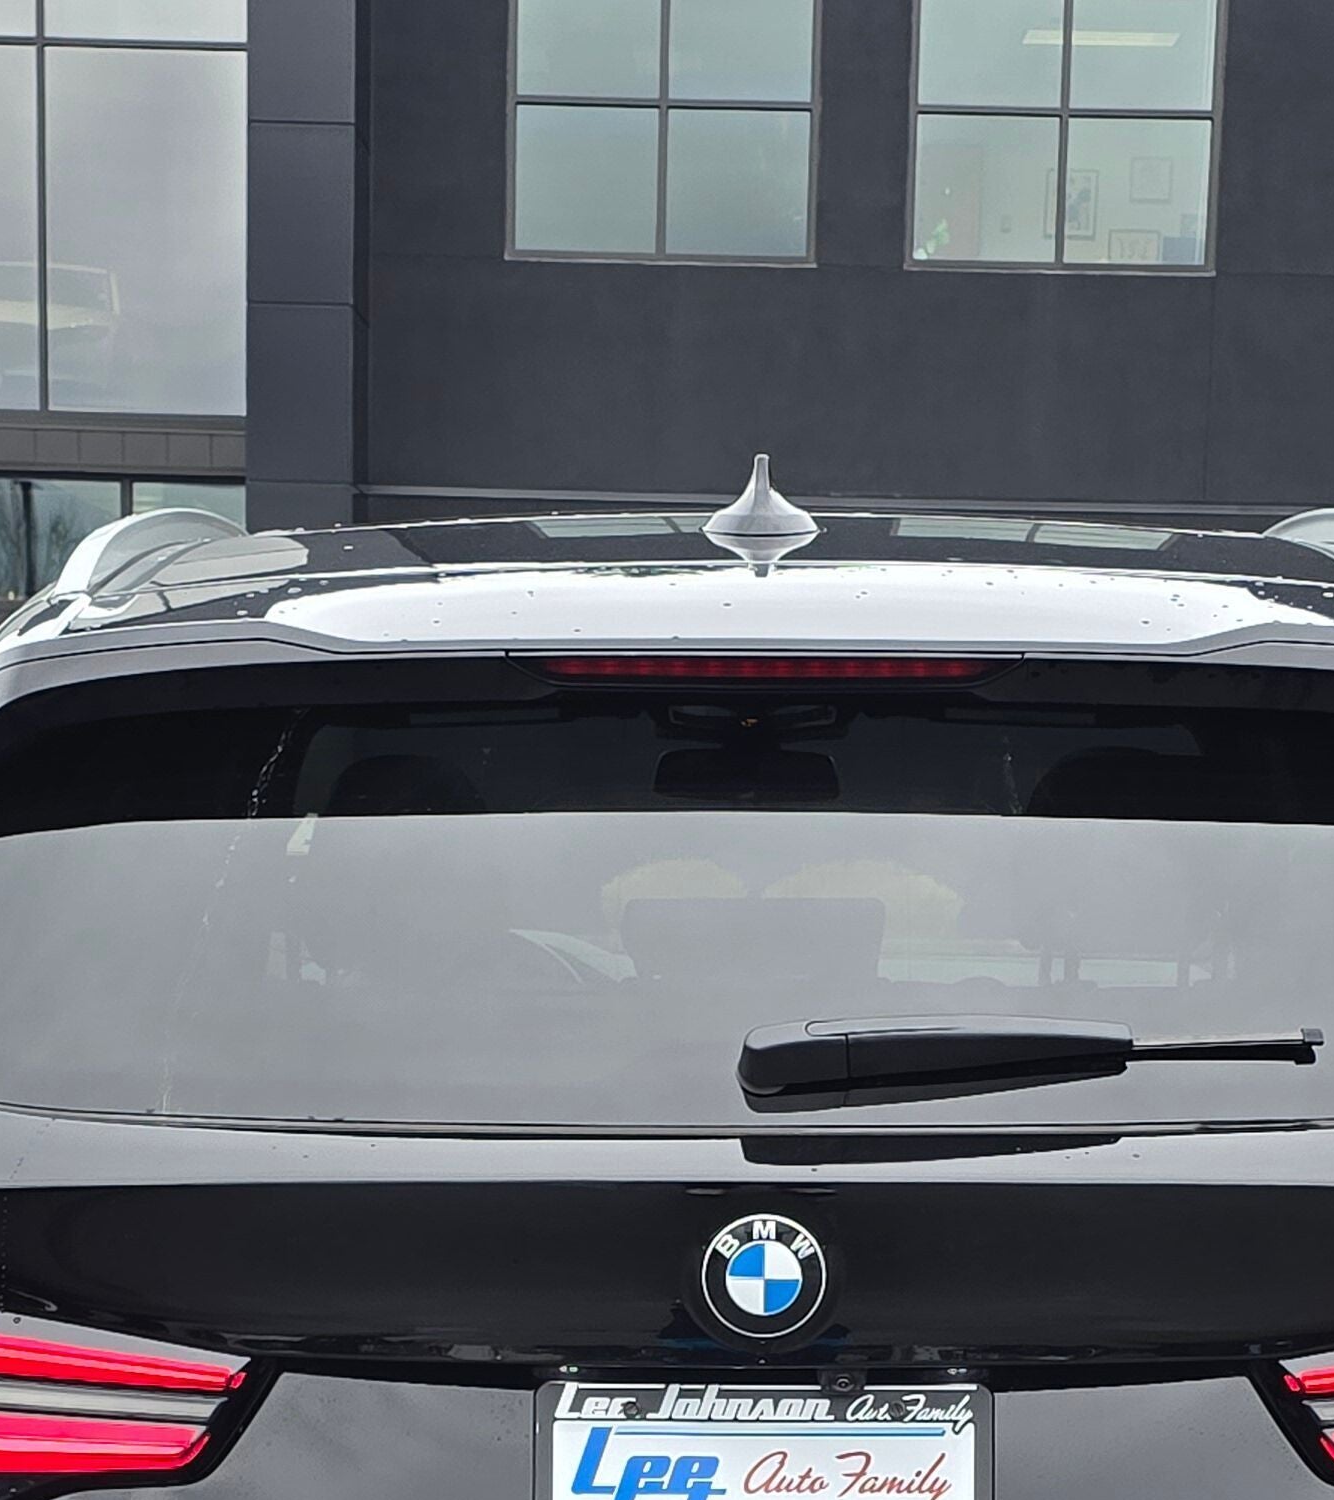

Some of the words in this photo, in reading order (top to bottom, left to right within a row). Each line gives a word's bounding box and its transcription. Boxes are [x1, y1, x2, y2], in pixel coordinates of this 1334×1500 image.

[714, 1220, 815, 1260] BMW
[646, 1383, 835, 1421] Johnson
[846, 1394, 903, 1421] Aut
[902, 1394, 974, 1432] Family
[571, 1427, 726, 1495] Lee
[743, 1450, 829, 1496] Auto
